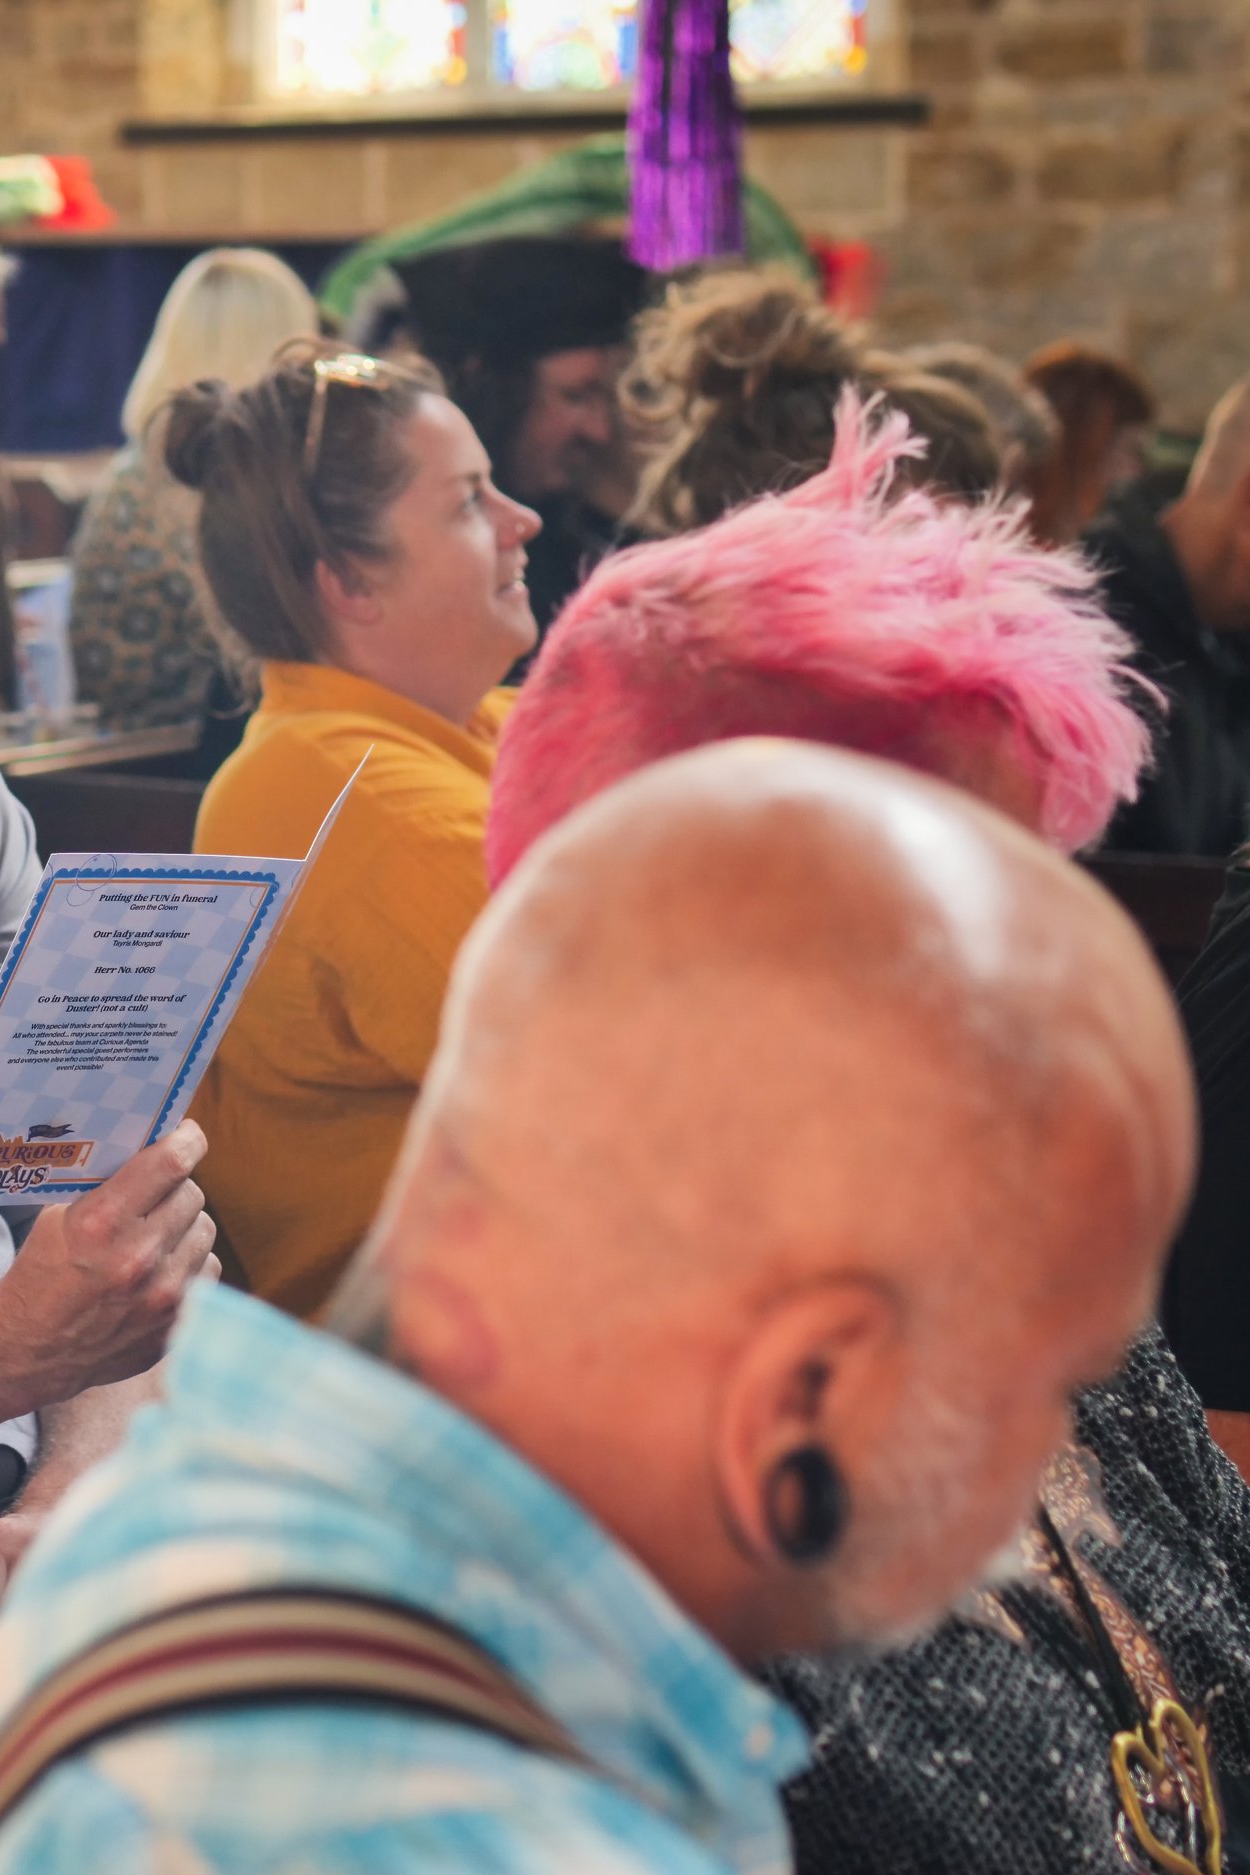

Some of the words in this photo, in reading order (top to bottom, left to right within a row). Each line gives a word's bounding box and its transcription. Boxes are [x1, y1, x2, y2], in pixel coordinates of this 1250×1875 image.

[98, 893, 133, 903] Putting
[134, 894, 148, 902] the
[149, 894, 170, 902] FUN
[170, 894, 180, 902] in
[93, 930, 112, 938] Our
[112, 930, 134, 939] lady
[134, 930, 154, 938] and
[154, 930, 190, 938] saviour
[94, 966, 117, 974] Herr
[118, 966, 132, 974] No.
[51, 994, 61, 1002] in
[62, 995, 89, 1003] Peace
[100, 994, 132, 1003] spread
[134, 994, 149, 1002] the
[149, 994, 174, 1002] word
[175, 994, 186, 1003] of
[66, 1004, 100, 1013] Duster!
[100, 1004, 118, 1013] (not
[127, 1004, 148, 1012] cult)
